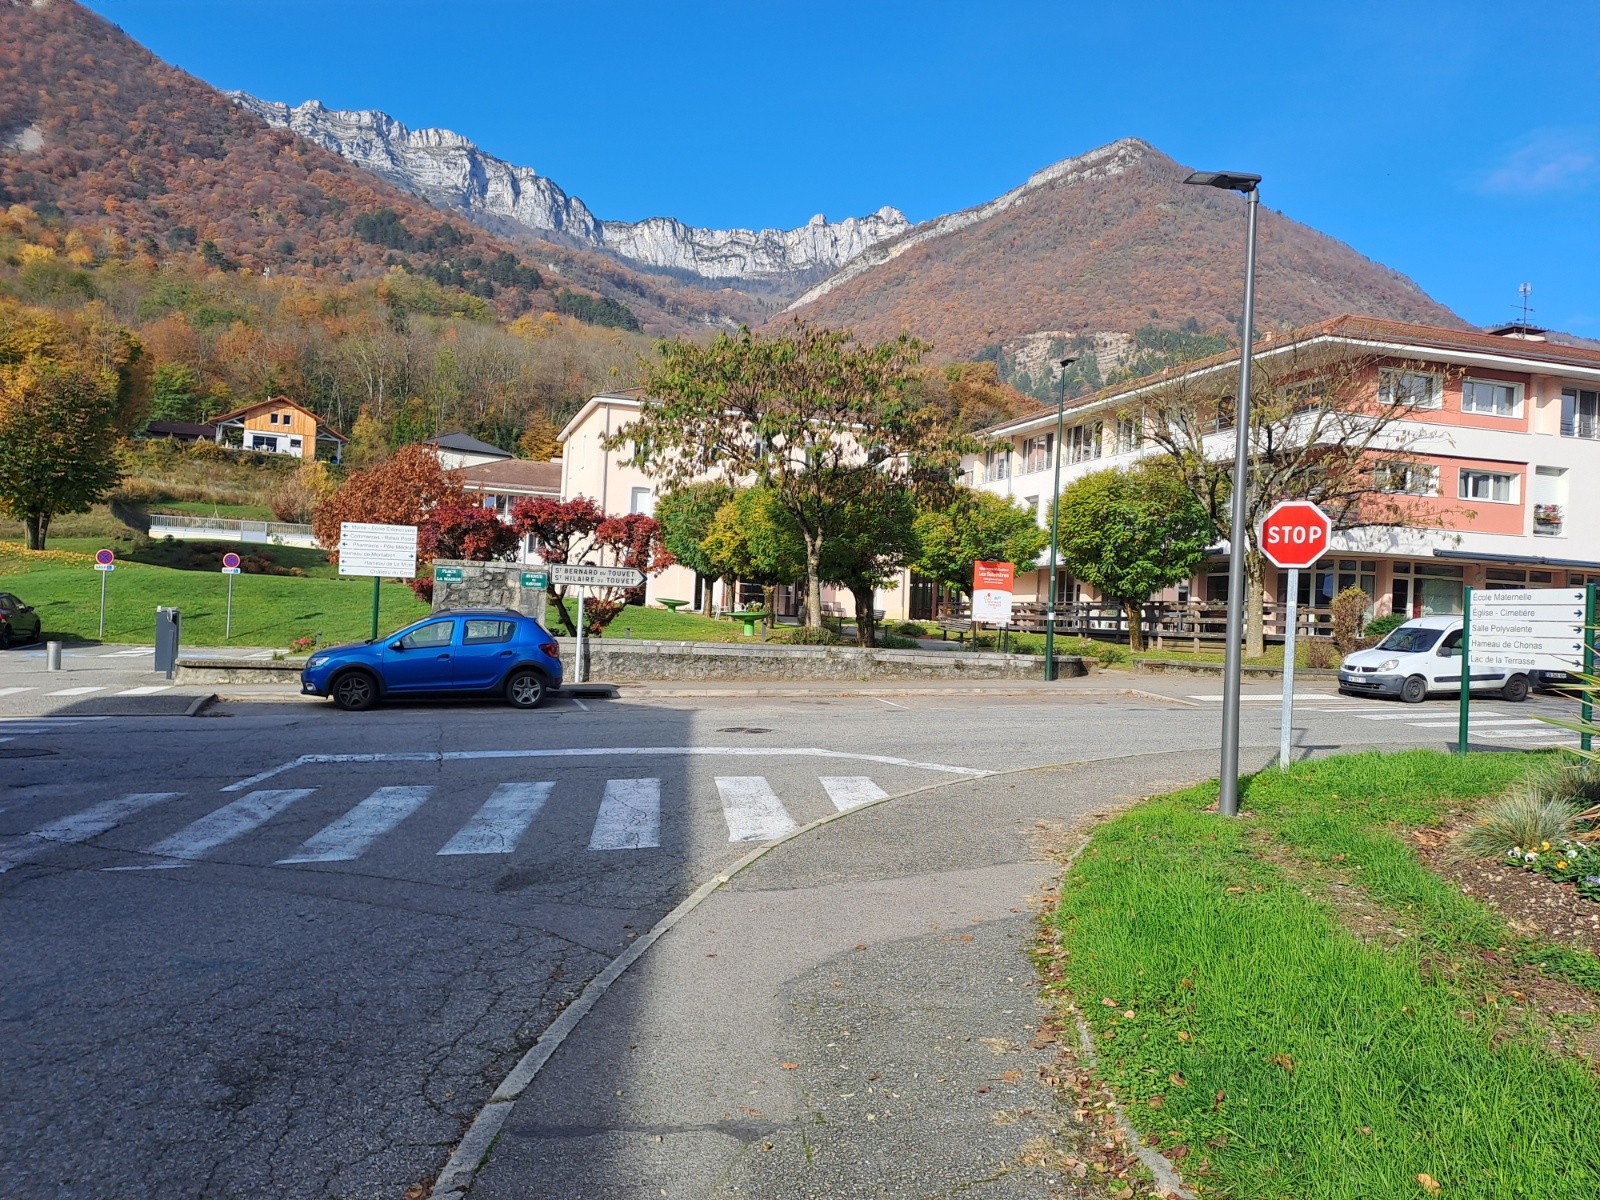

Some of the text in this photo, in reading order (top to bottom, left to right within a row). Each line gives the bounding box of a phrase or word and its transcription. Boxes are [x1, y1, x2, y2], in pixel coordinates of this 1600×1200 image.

[1268, 526, 1322, 544] STOP
[1473, 592, 1492, 601] École
[1473, 608, 1493, 618] Église
[1491, 625, 1532, 634] Polyvalente
[1514, 641, 1542, 649] Chonas
[1504, 657, 1535, 665] Terrasse
